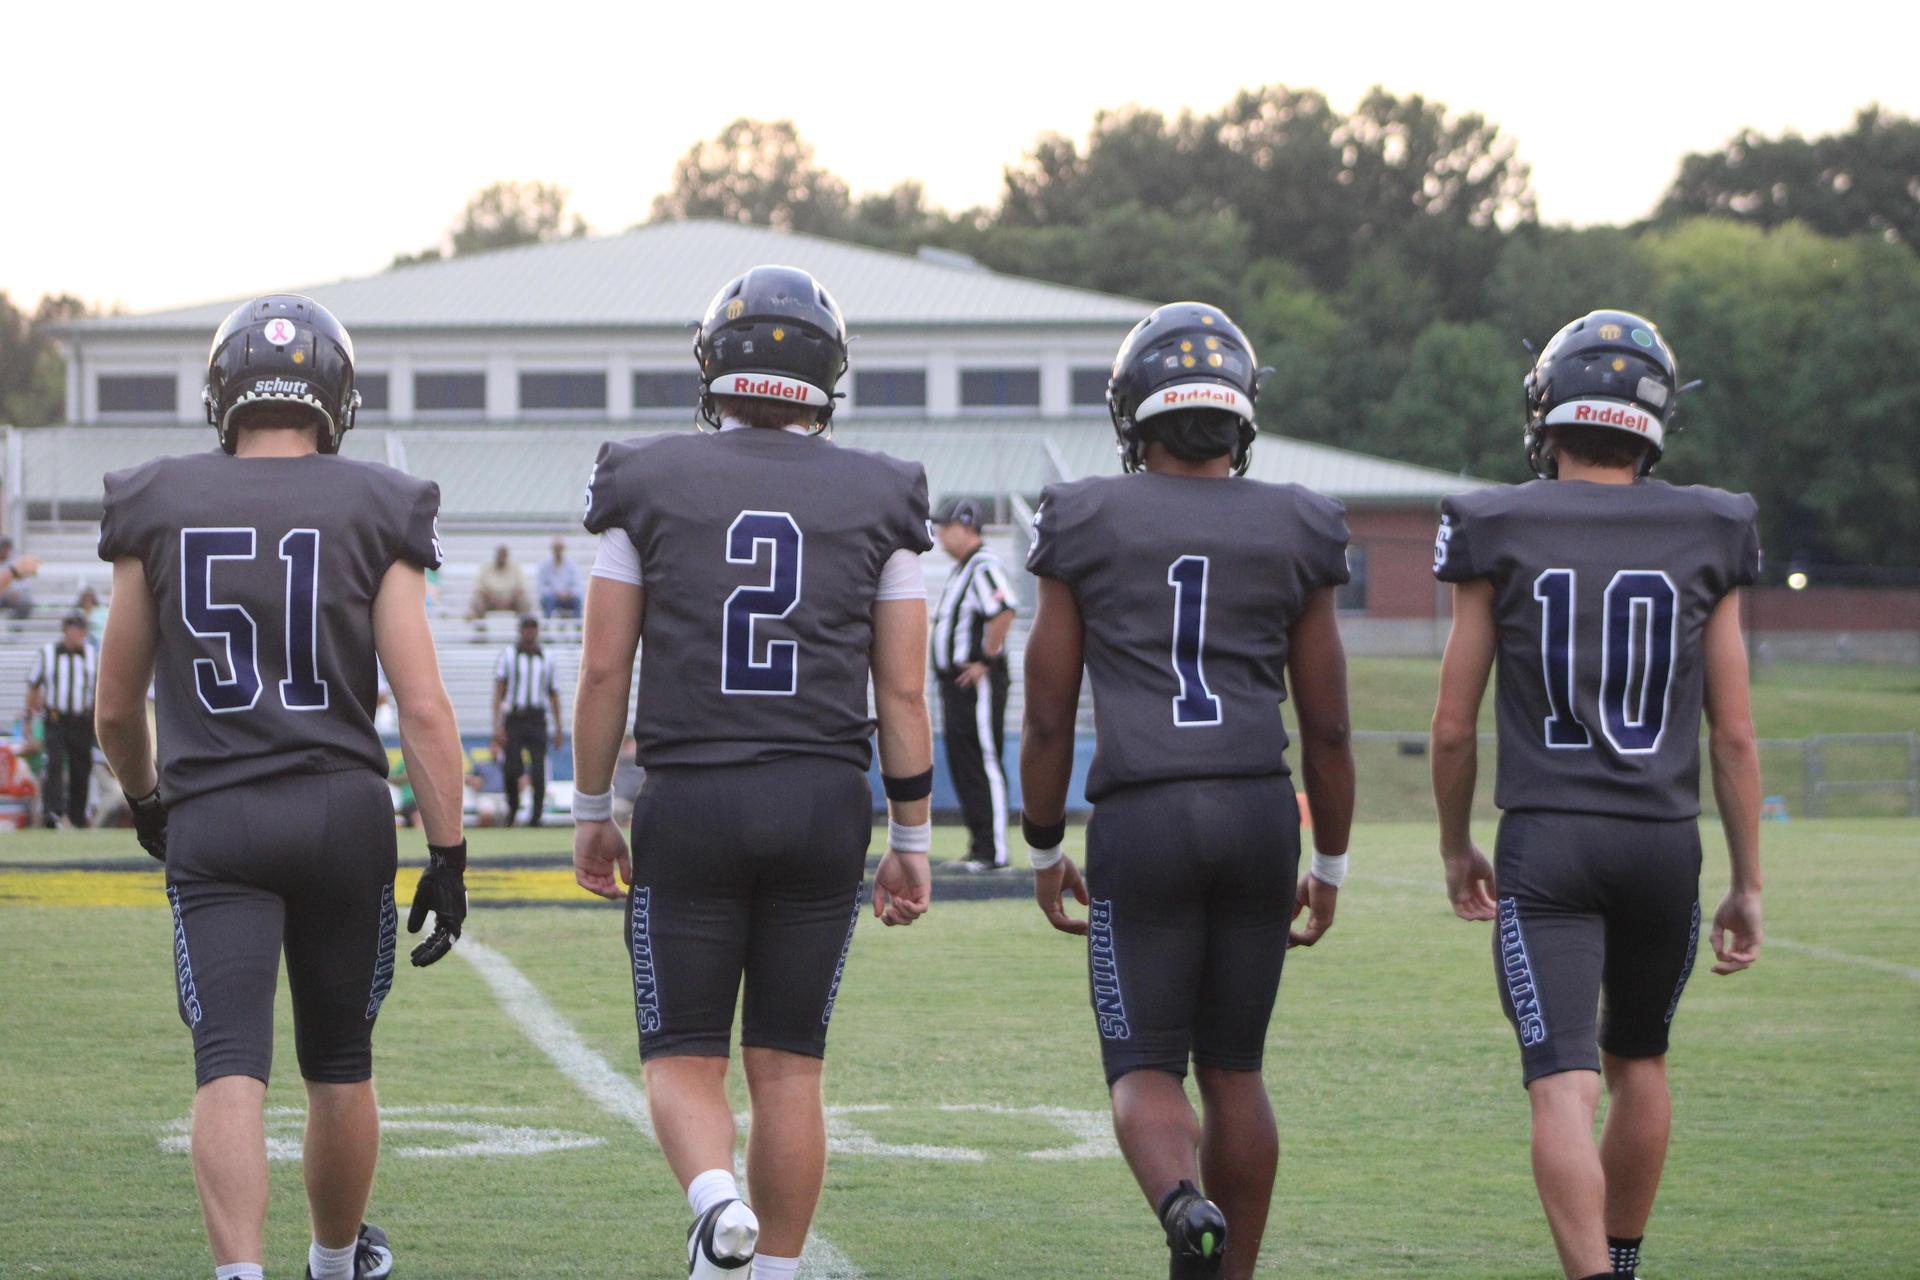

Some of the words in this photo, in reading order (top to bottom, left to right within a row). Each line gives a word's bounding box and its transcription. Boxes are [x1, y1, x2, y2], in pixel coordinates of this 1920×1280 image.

[734, 377, 808, 401] Riddell
[1575, 405, 1648, 432] Riddell
[180, 527, 329, 714] 51
[721, 510, 803, 695] 2
[1168, 554, 1222, 727] 1
[1533, 568, 1678, 755] 10
[632, 885, 661, 1032] BRUINS
[1090, 897, 1131, 1039] BRUINS
[1499, 896, 1545, 1047] BRUINS
